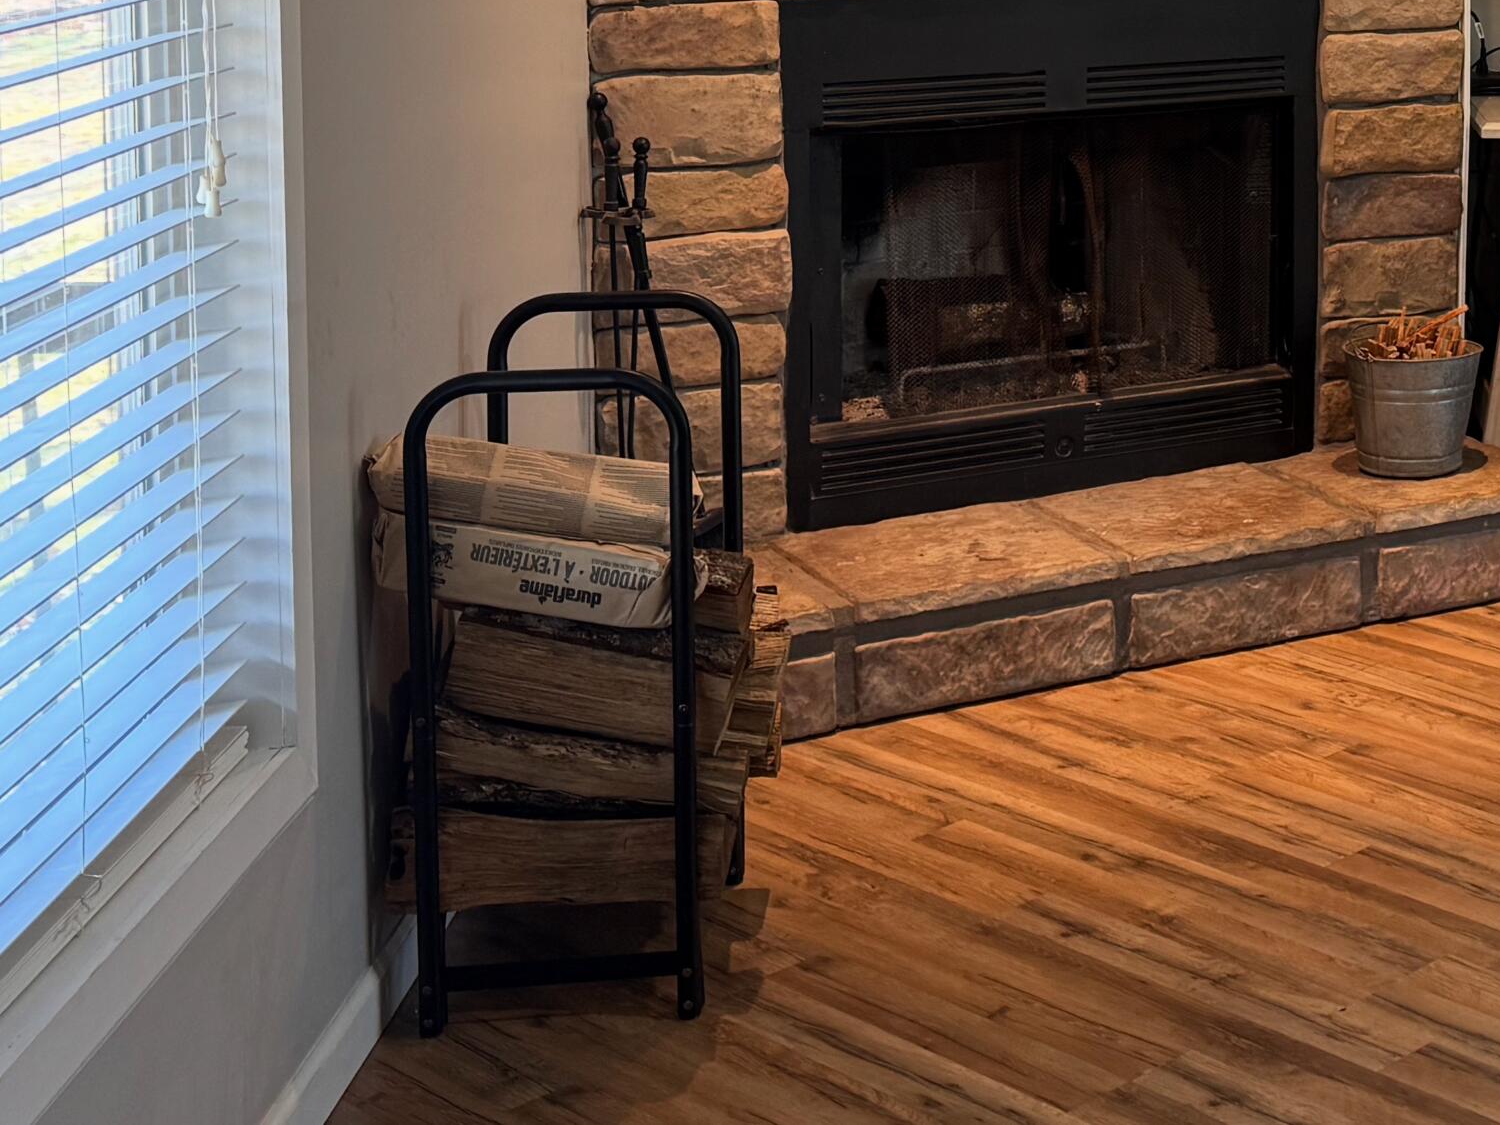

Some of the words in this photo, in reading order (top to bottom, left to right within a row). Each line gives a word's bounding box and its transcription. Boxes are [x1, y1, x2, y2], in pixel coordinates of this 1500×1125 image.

[470, 542, 561, 576] L'EXTÉRIEUR
[564, 560, 576, 584] À
[519, 578, 602, 608] duraflame
